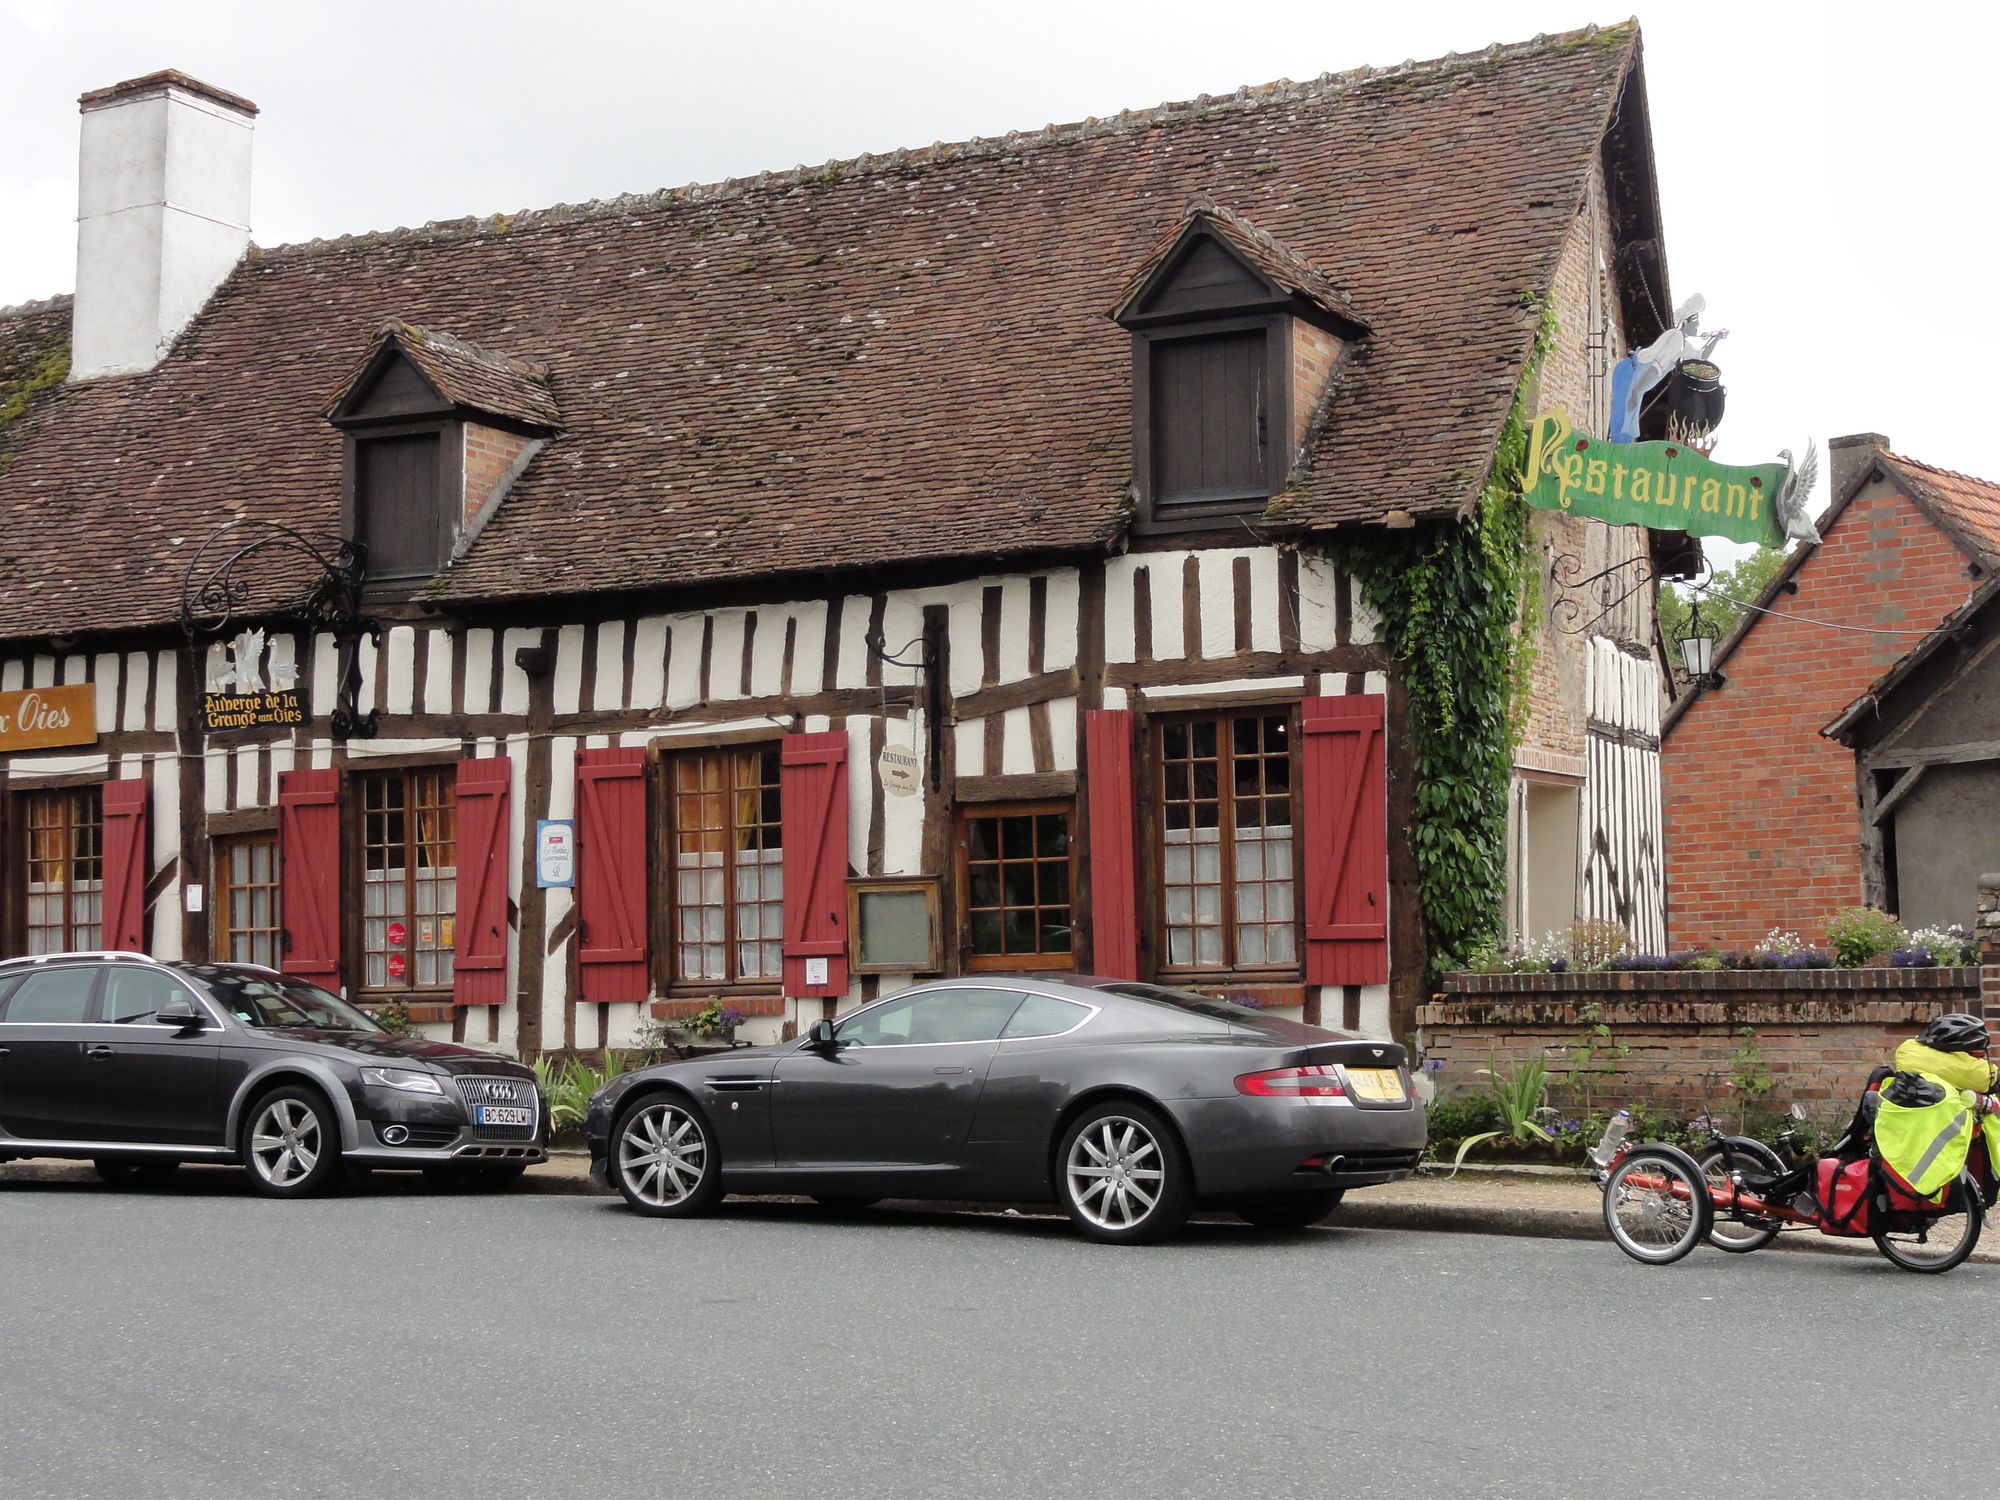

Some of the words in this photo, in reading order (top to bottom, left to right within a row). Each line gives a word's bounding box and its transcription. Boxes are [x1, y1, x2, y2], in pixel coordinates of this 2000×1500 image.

[1517, 405, 1764, 520] Restaurant
[17, 693, 70, 731] Oies
[204, 694, 261, 714] Auberge
[265, 694, 280, 709] de
[282, 694, 298, 708] la
[207, 711, 257, 729] Grange
[258, 713, 273, 722] aux
[273, 708, 302, 723] Oies
[882, 751, 917, 768] RESTAURANT
